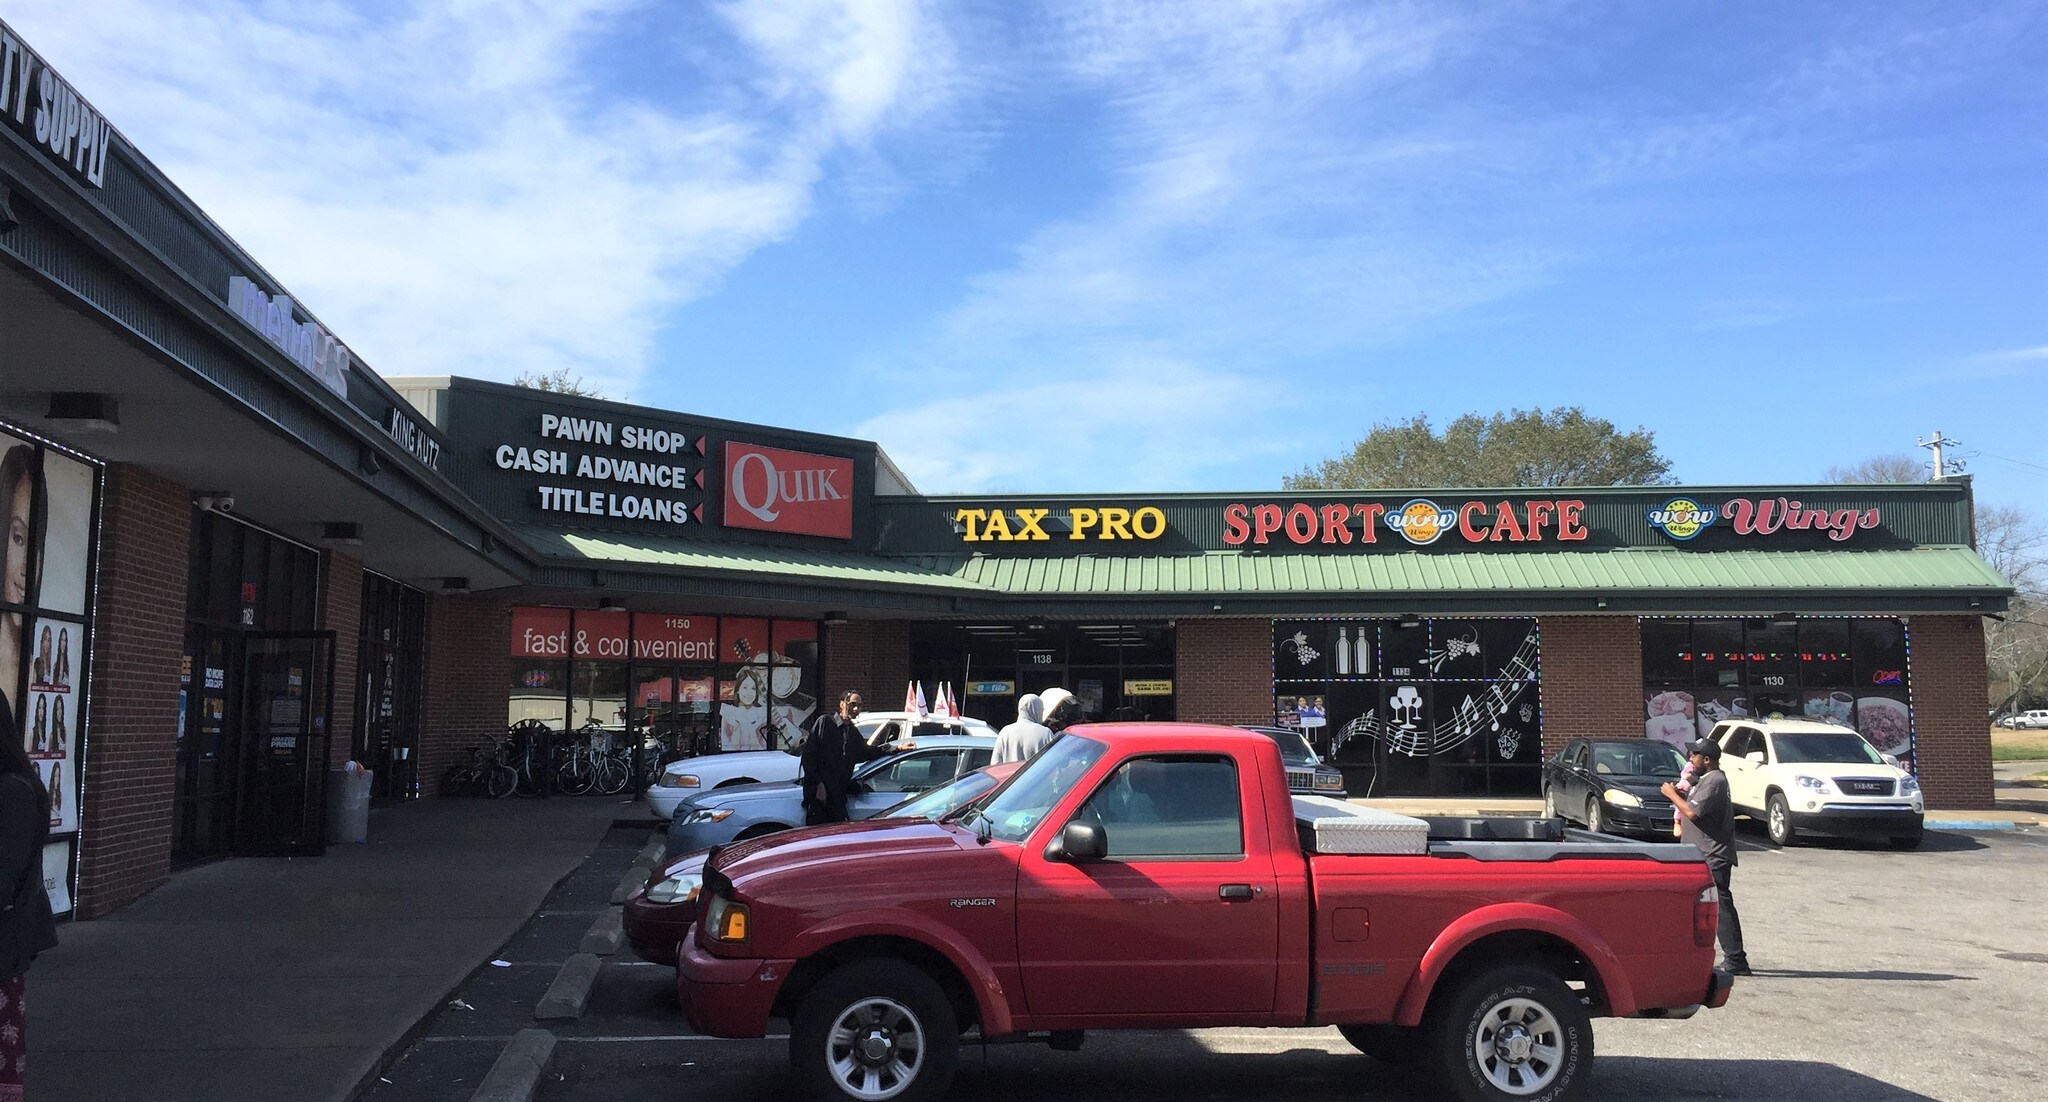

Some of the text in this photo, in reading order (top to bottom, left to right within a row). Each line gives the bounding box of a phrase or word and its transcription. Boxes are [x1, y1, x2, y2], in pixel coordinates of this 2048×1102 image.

[35, 66, 111, 189] SUPPLY
[391, 407, 440, 471] KING KUTZ
[541, 413, 686, 454] PAWN SHOP
[496, 444, 686, 489] CASH ADVANCE
[538, 485, 688, 524] TITLE LOANS
[1223, 500, 1588, 545] SPORT CAFE
[1722, 497, 1880, 542] Wings
[956, 506, 1167, 542] TAX PRO
[664, 619, 690, 629] 1150
[524, 628, 715, 660] fast & convenient
[1032, 655, 1052, 664] 1138
[1392, 667, 1411, 676] 1134
[1763, 676, 1784, 686] 1130
[1873, 670, 1901, 683] Open
[950, 898, 996, 908] RANGER
